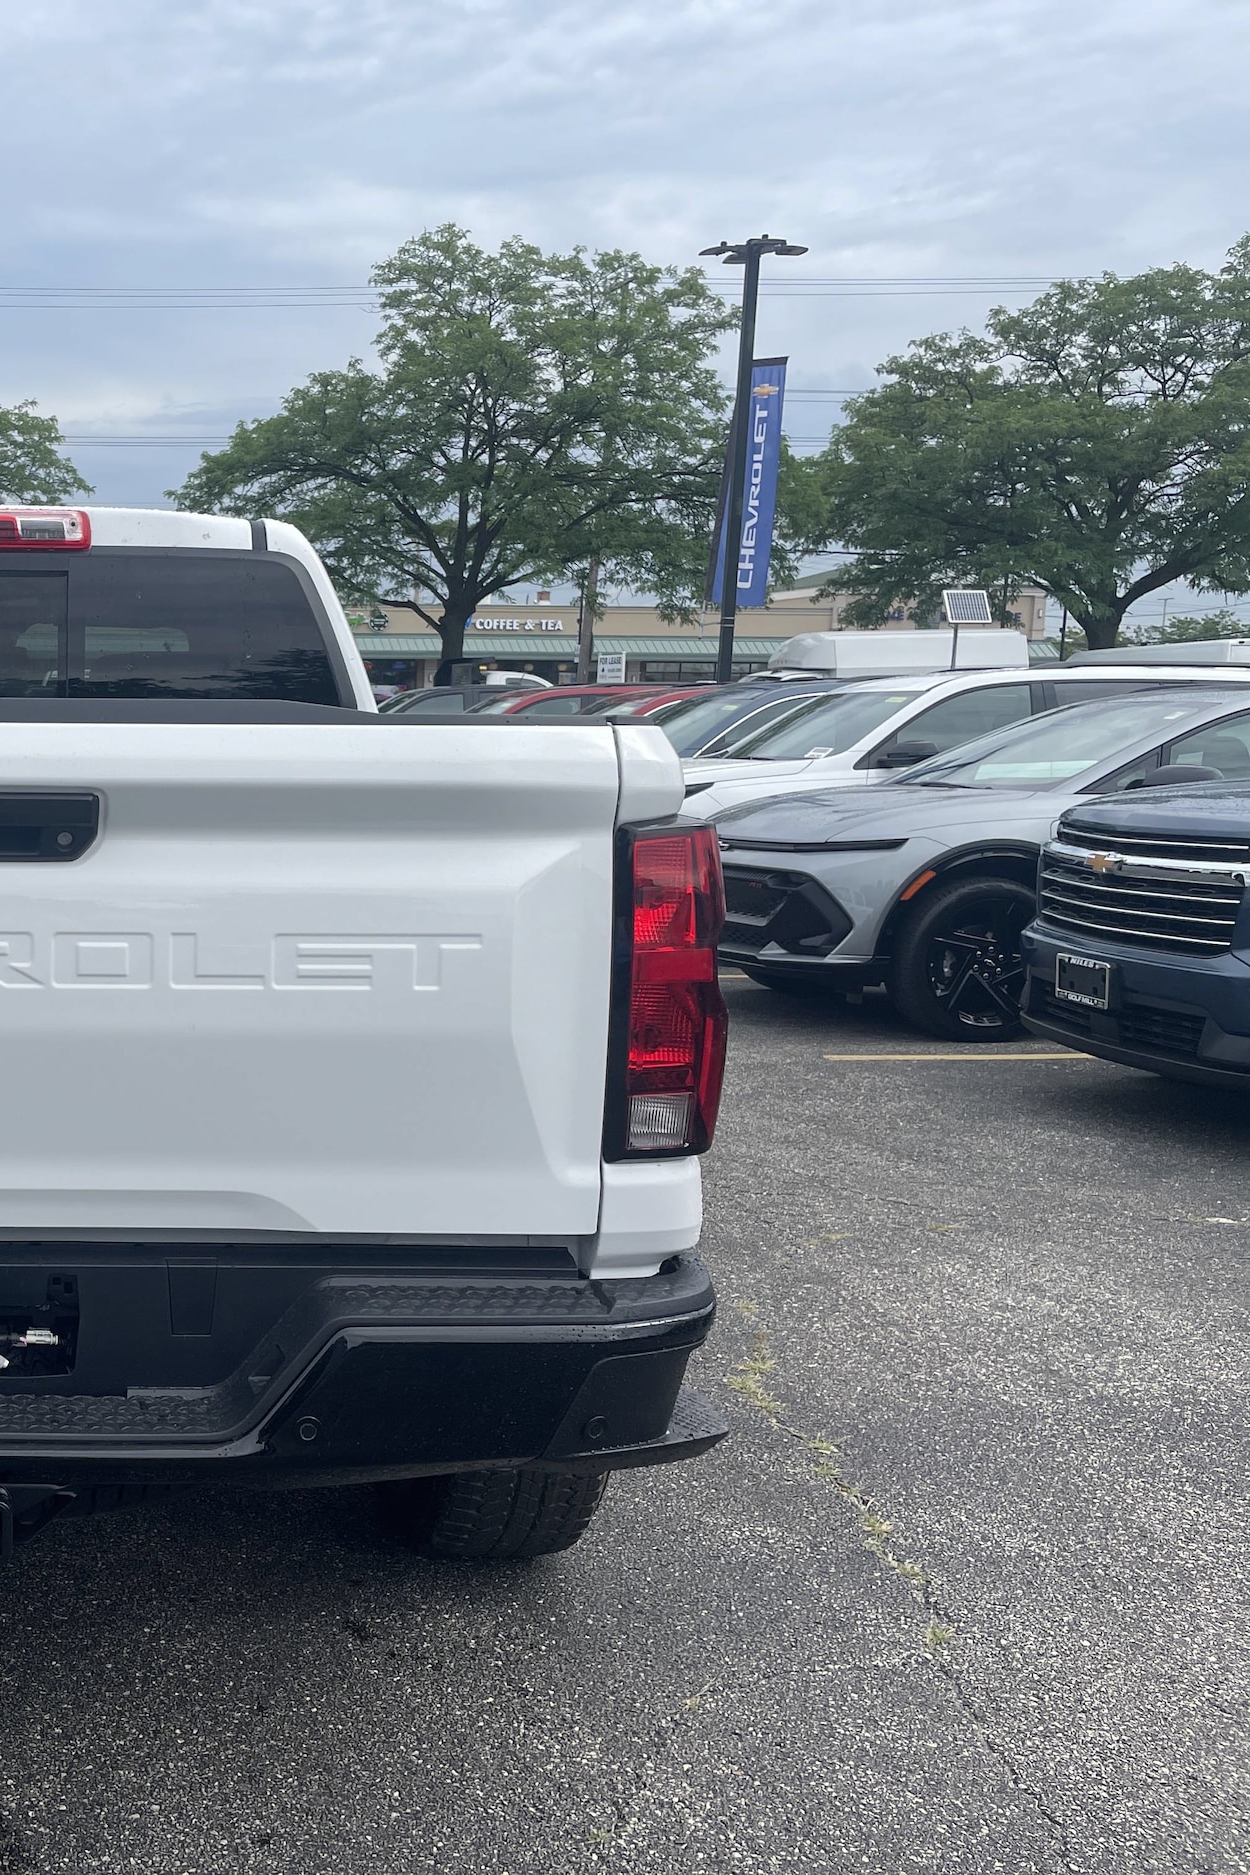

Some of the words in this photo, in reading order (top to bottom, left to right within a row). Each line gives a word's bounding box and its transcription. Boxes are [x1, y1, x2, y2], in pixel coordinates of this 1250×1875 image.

[737, 404, 768, 589] CHEVROLET
[475, 619, 520, 630] COFFEE
[524, 619, 535, 630] &
[540, 619, 564, 630] TEA
[1070, 958, 1094, 968] NILES
[1081, 997, 1094, 1005] MILL
